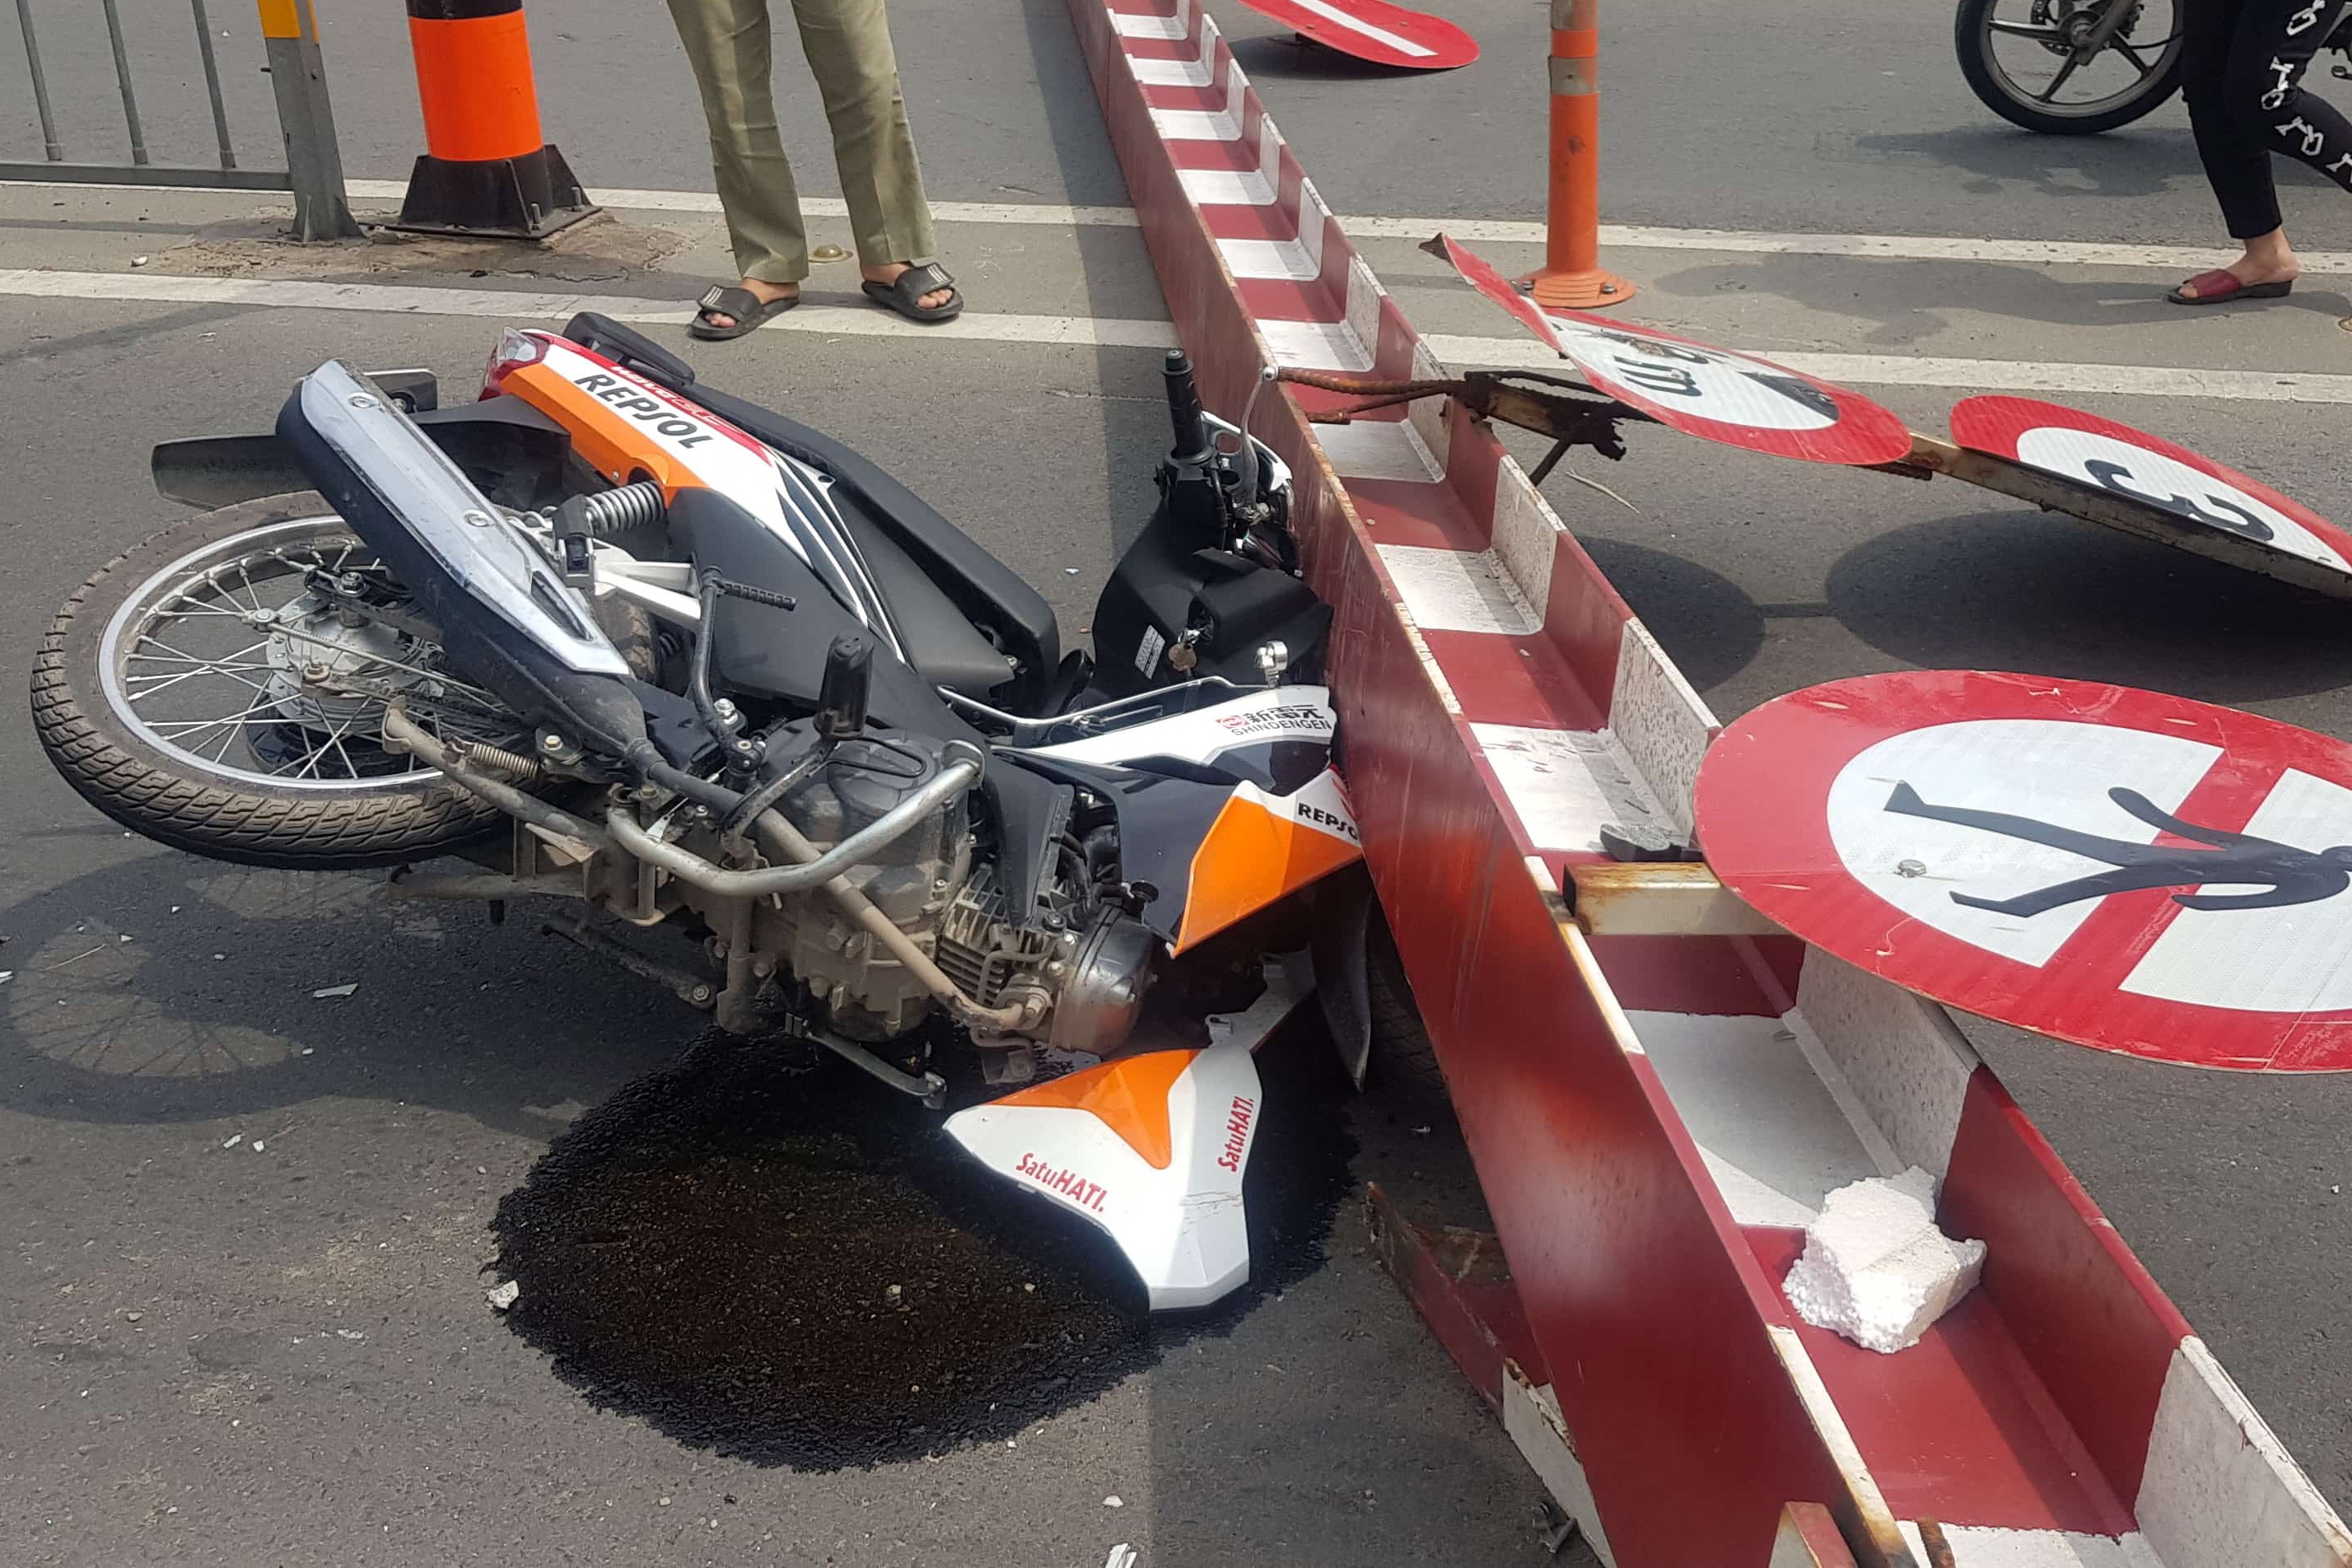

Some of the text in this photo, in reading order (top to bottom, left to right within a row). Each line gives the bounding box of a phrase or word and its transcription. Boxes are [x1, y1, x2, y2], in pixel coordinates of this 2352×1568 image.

[575, 374, 715, 449] REPSOL
[1231, 720, 1332, 735] SHINDENGEN
[1298, 802, 1359, 840] REPSO
[1216, 1095, 1254, 1173] SatuHATI.
[1015, 1152, 1108, 1213] SatuHATI.
